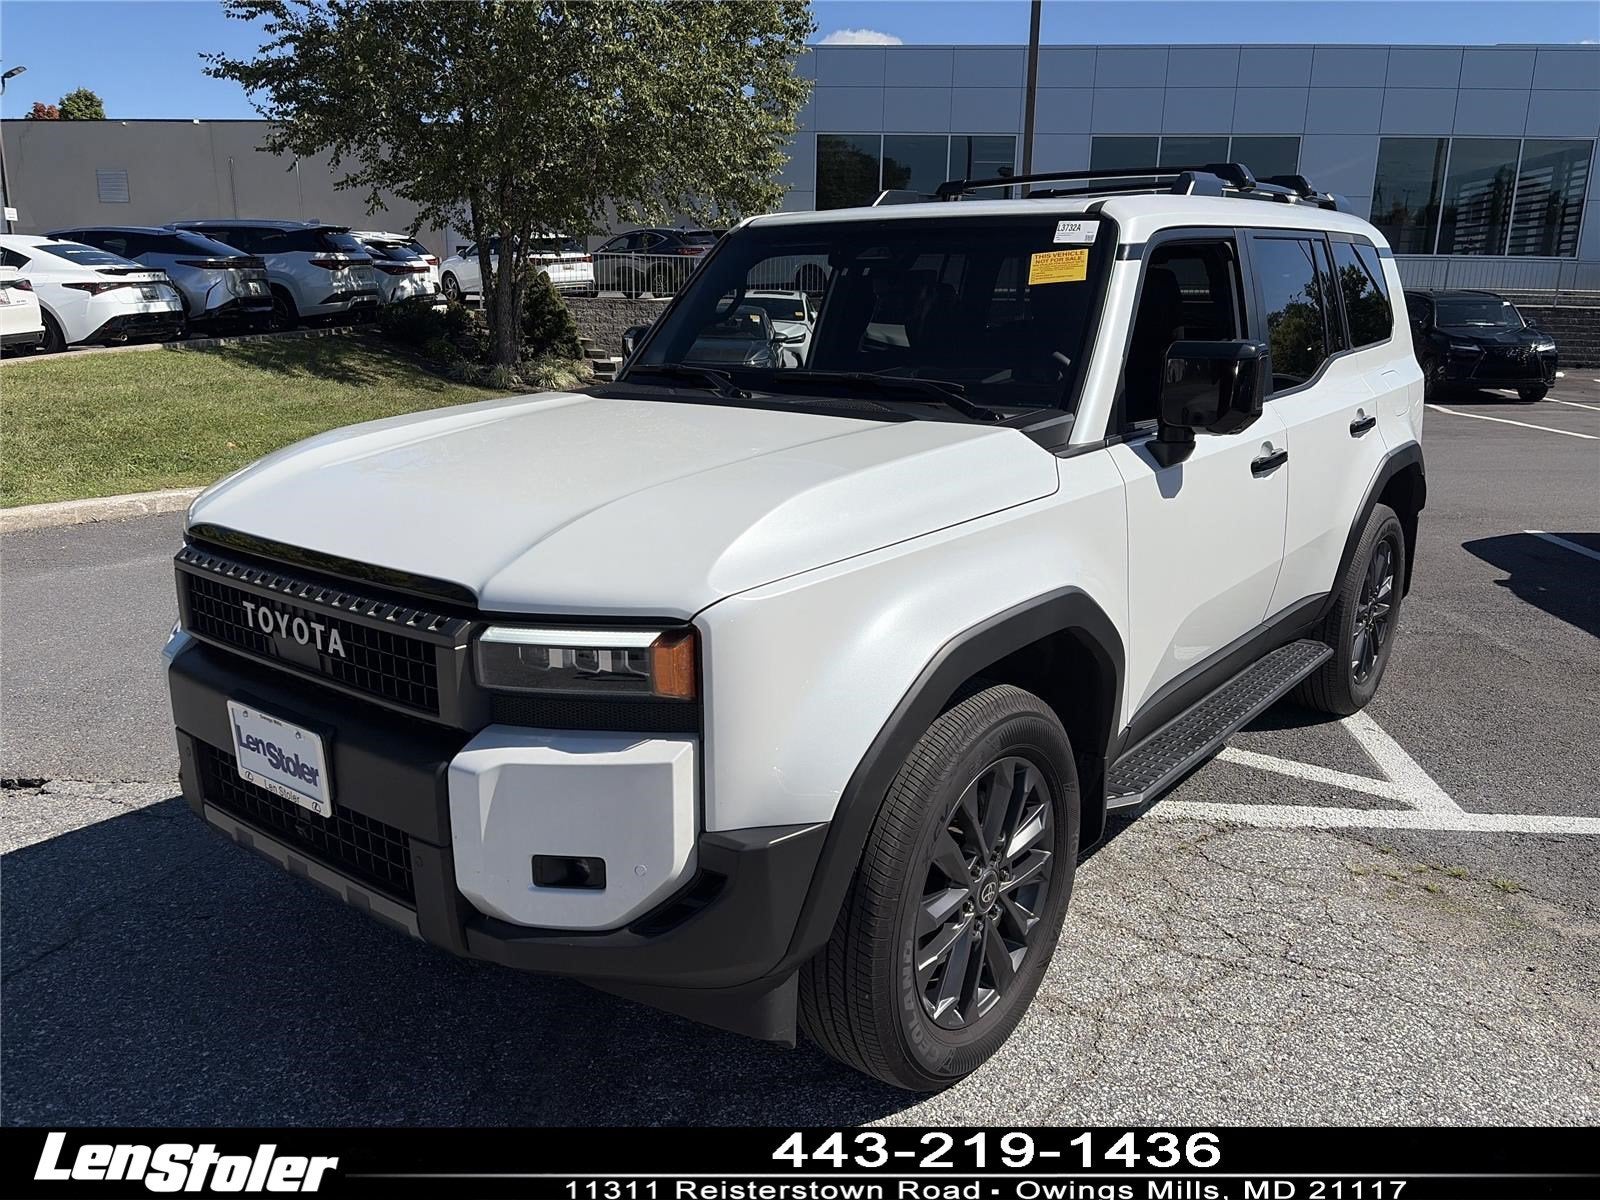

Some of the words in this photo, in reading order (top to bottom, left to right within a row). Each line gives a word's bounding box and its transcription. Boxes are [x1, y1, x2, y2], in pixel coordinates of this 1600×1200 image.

[1057, 223, 1081, 232] L3732A
[242, 600, 346, 658] TOYOTA
[264, 779, 278, 793] Len
[279, 784, 301, 803] Stoler
